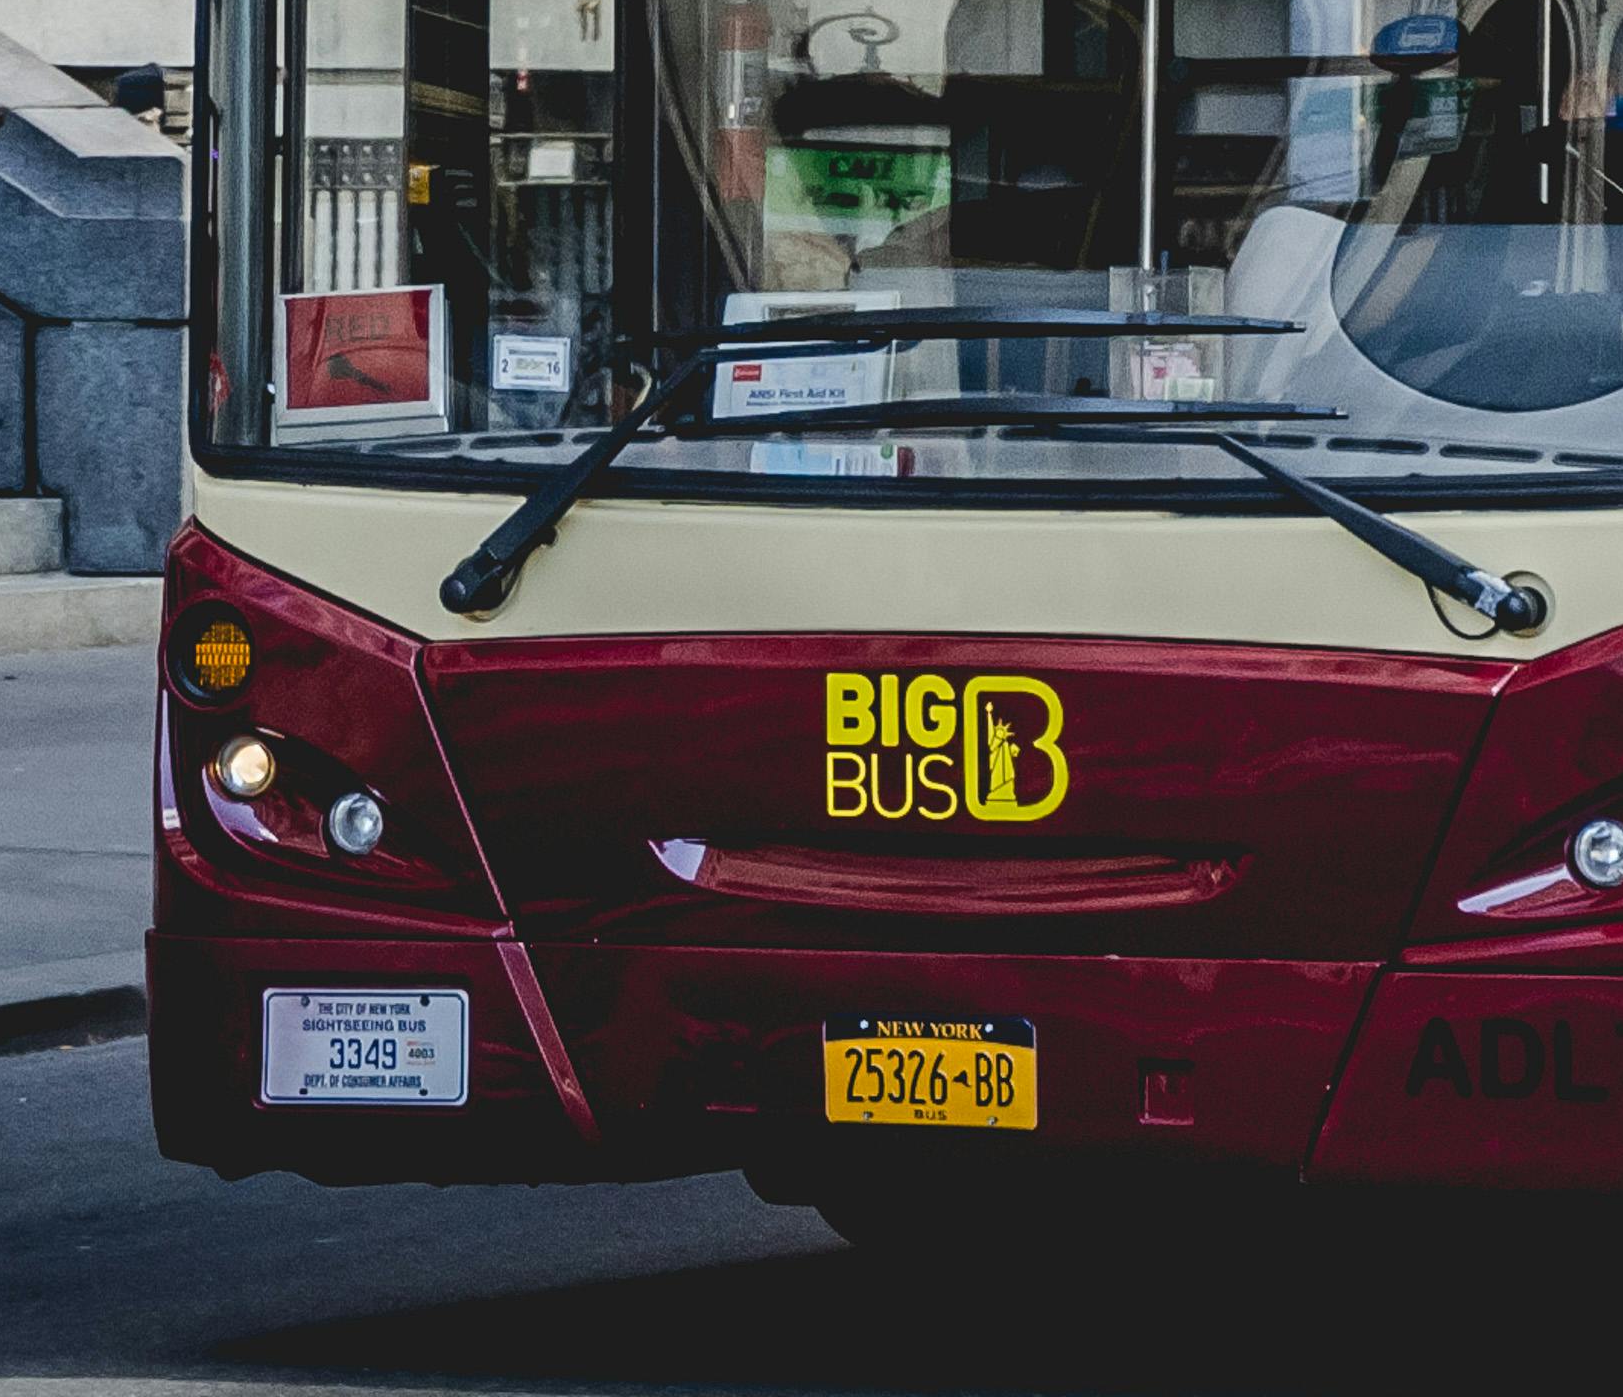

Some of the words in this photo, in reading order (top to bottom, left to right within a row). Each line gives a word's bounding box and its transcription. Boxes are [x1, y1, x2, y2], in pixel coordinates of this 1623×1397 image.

[826, 673, 957, 748] BIG
[826, 751, 958, 820] BUS
[369, 1003, 388, 1016] NEW
[389, 1003, 411, 1016] YORK
[302, 1019, 395, 1033] SIGHTSEEING
[397, 1019, 427, 1033] BUS
[877, 1020, 923, 1038] NEW
[930, 1021, 984, 1040] YORK
[329, 1038, 397, 1070] 3349
[914, 1109, 948, 1121] BUS
